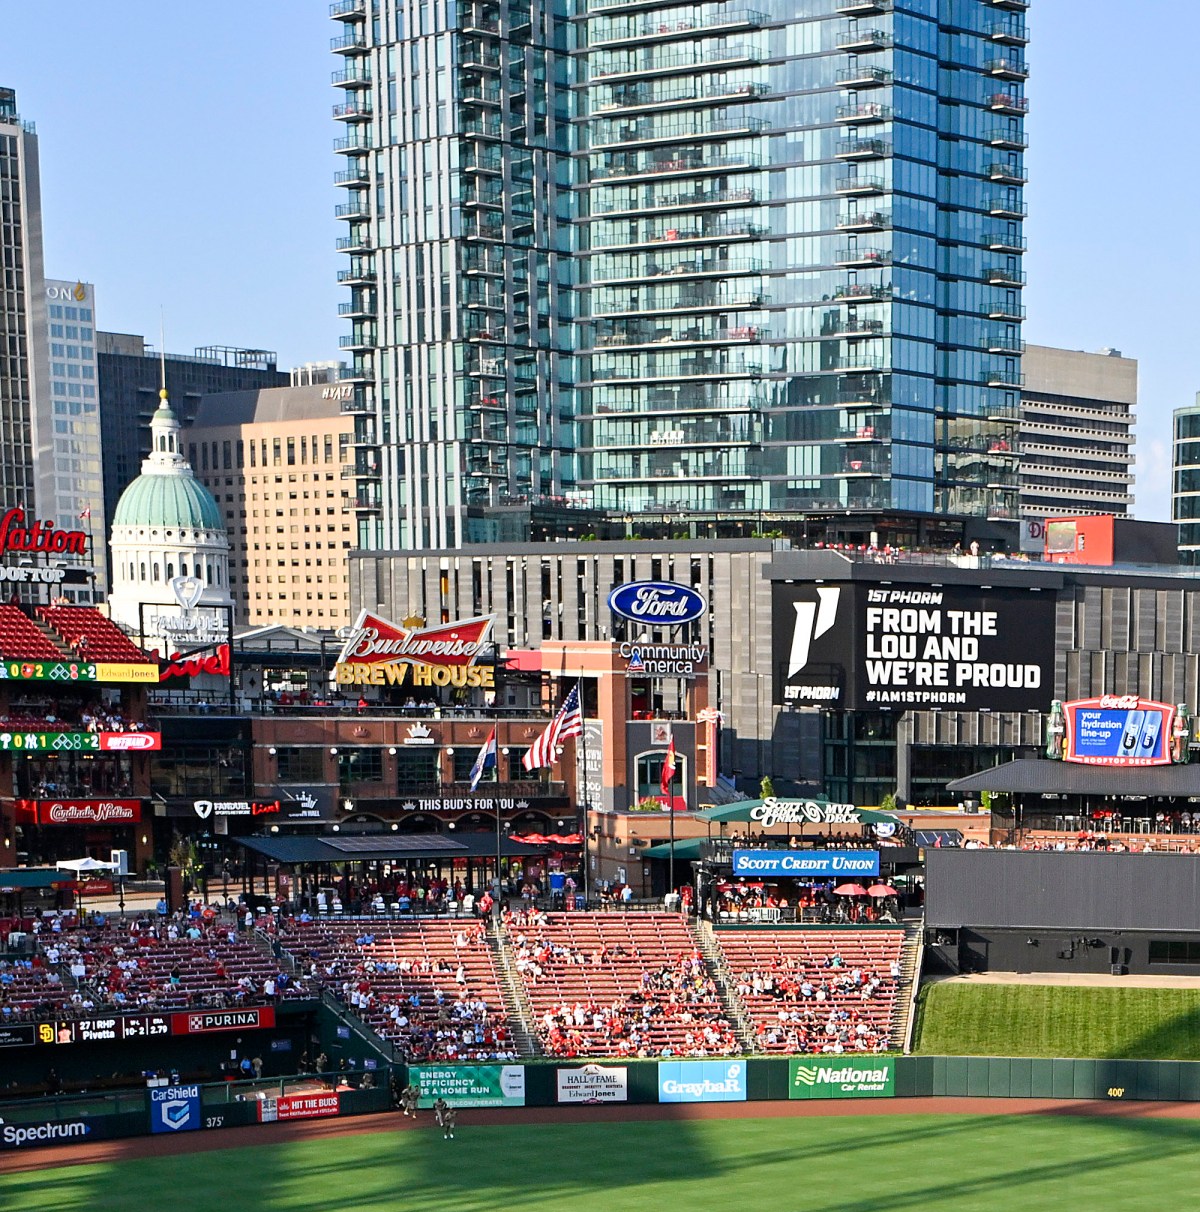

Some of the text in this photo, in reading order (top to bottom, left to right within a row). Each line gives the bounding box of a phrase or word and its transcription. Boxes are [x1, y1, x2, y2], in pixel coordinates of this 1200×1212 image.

[631, 587, 689, 617] Ford
[866, 608, 998, 636] FROM THE
[336, 626, 494, 657] Budweiser
[866, 634, 978, 662] LOU AND
[620, 642, 706, 663] Community
[336, 662, 495, 688] BREW HOUSE
[866, 660, 1040, 688] WE'RE PROUD
[866, 690, 966, 704] #IAM1STPHORM
[1082, 712, 1102, 720] your
[1082, 720, 1122, 729] hydration
[1082, 729, 1111, 738] line-up
[418, 798, 493, 810] THIS BUD'S FOR
[825, 804, 855, 814] MVP
[50, 802, 134, 822] Cardinals Nation
[825, 814, 861, 824] DECK
[738, 856, 874, 870] SCOTT CREDIT UNION
[96, 1020, 116, 1029] RHP
[206, 1013, 256, 1026] PURINA
[82, 1030, 116, 1040] Pivetta
[567, 1075, 617, 1084] HALL FAME
[151, 1086, 198, 1101] CarShield
[662, 1080, 740, 1096] GraybaR
[841, 1083, 884, 1092] Car Rental
[1108, 1088, 1124, 1097] 400'
[292, 1097, 338, 1110] HIT THE BUDS
[206, 1116, 224, 1128] 375'
[4, 1122, 86, 1145] Spectrum
